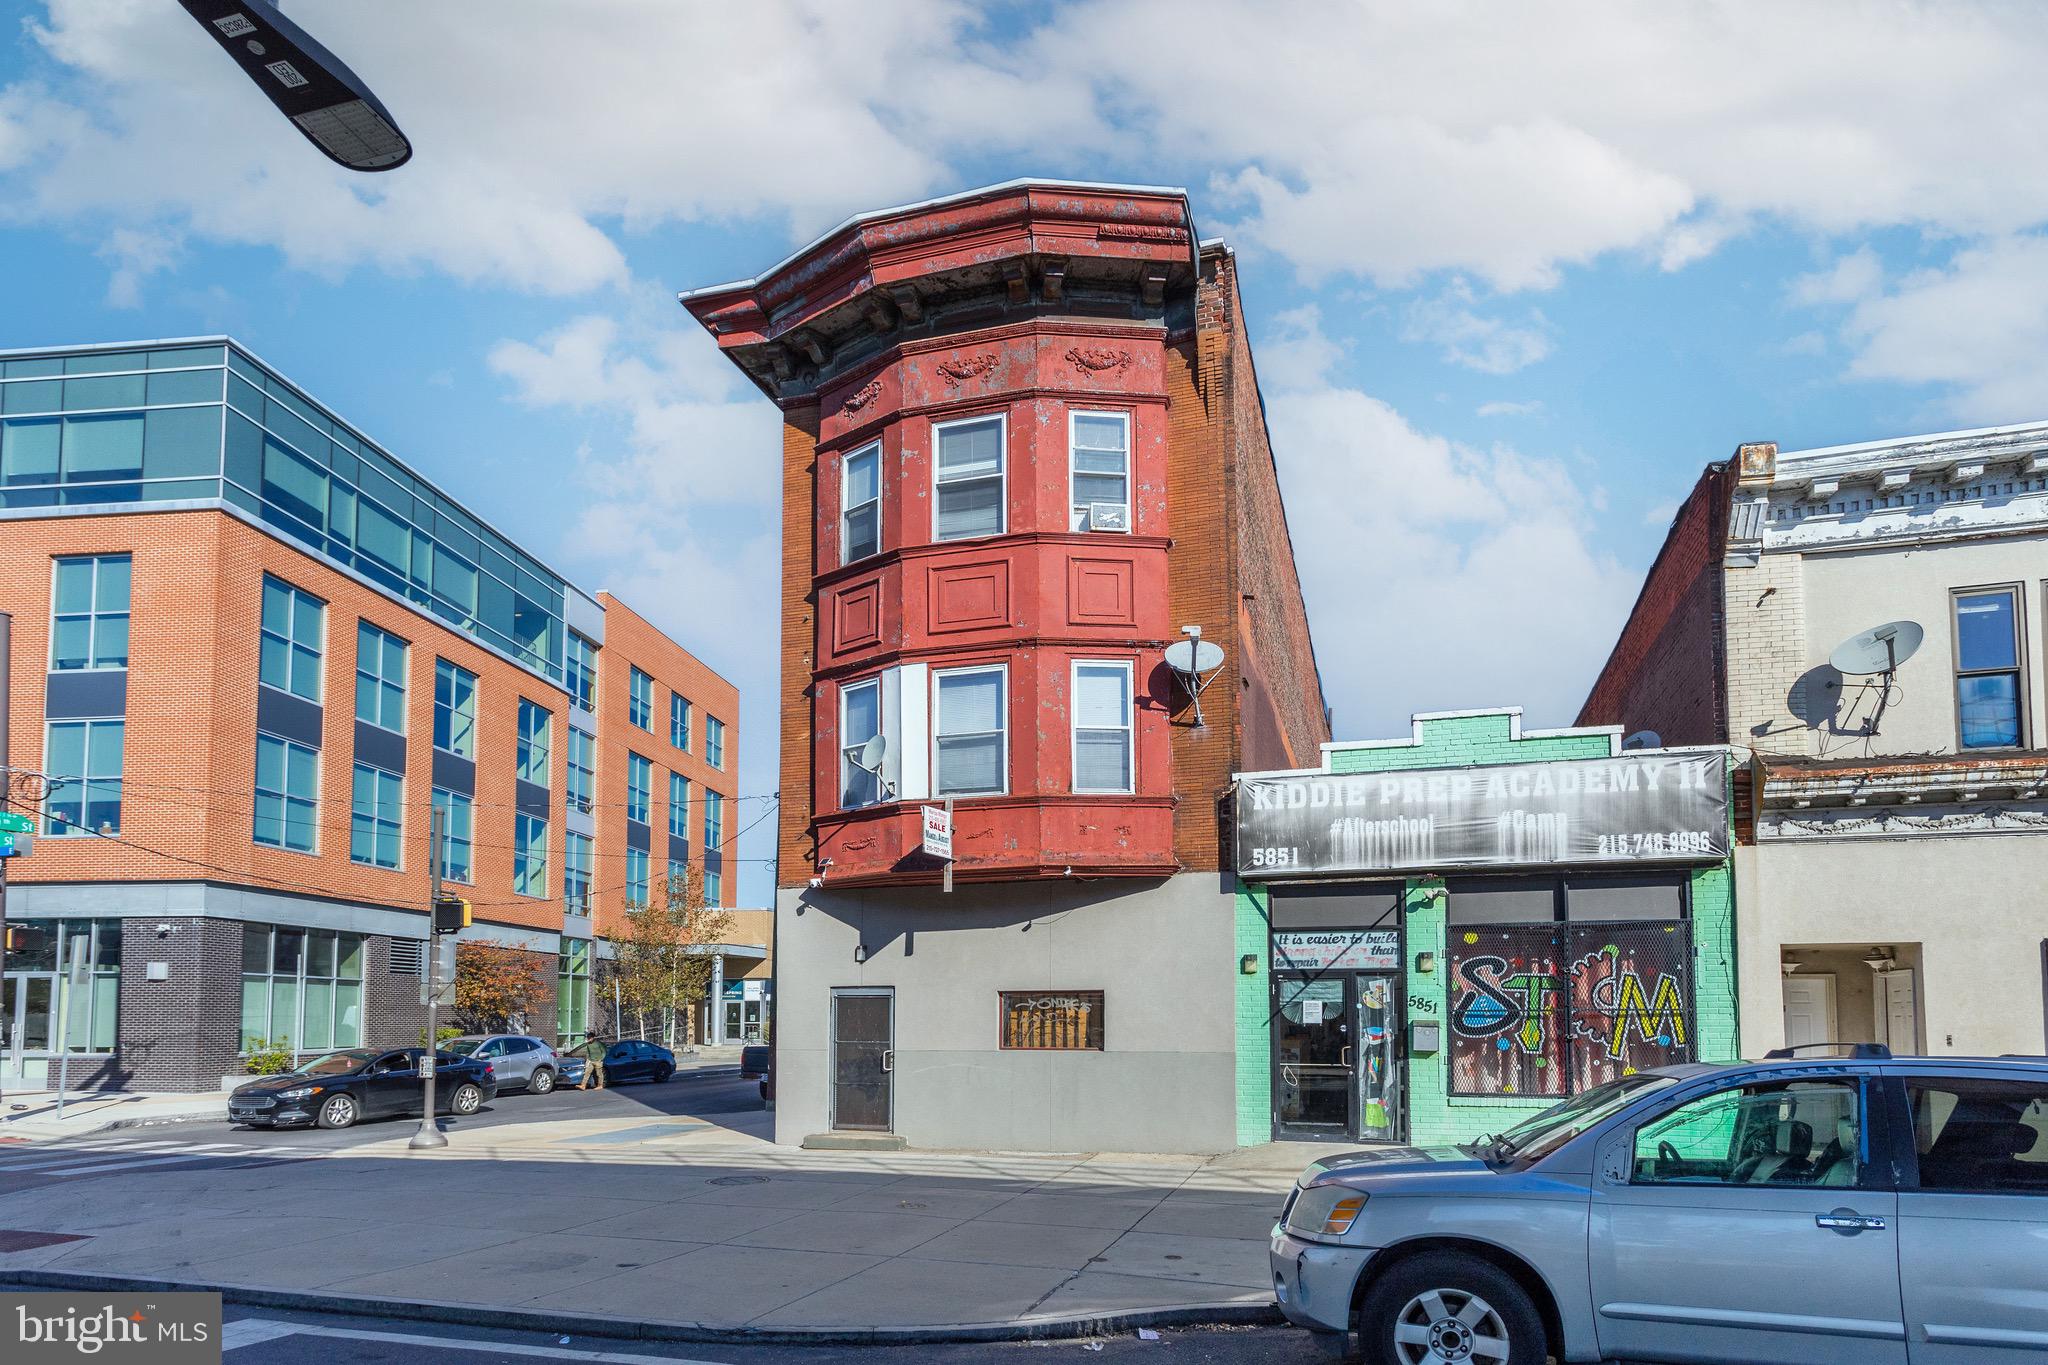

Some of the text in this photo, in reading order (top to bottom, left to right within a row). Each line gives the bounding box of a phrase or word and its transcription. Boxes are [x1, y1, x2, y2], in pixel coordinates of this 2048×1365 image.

[272, 61, 295, 76] LED
[1252, 760, 1707, 811] KIDDIE PREP ACADEMY II
[21, 822, 34, 832] St
[928, 820, 946, 833] SALE
[1329, 813, 1435, 836] #Afterschool
[4, 836, 13, 846] St
[1252, 846, 1299, 866] 5851
[1278, 932, 1400, 945] It is easier to build
[1408, 995, 1437, 1014] 5851
